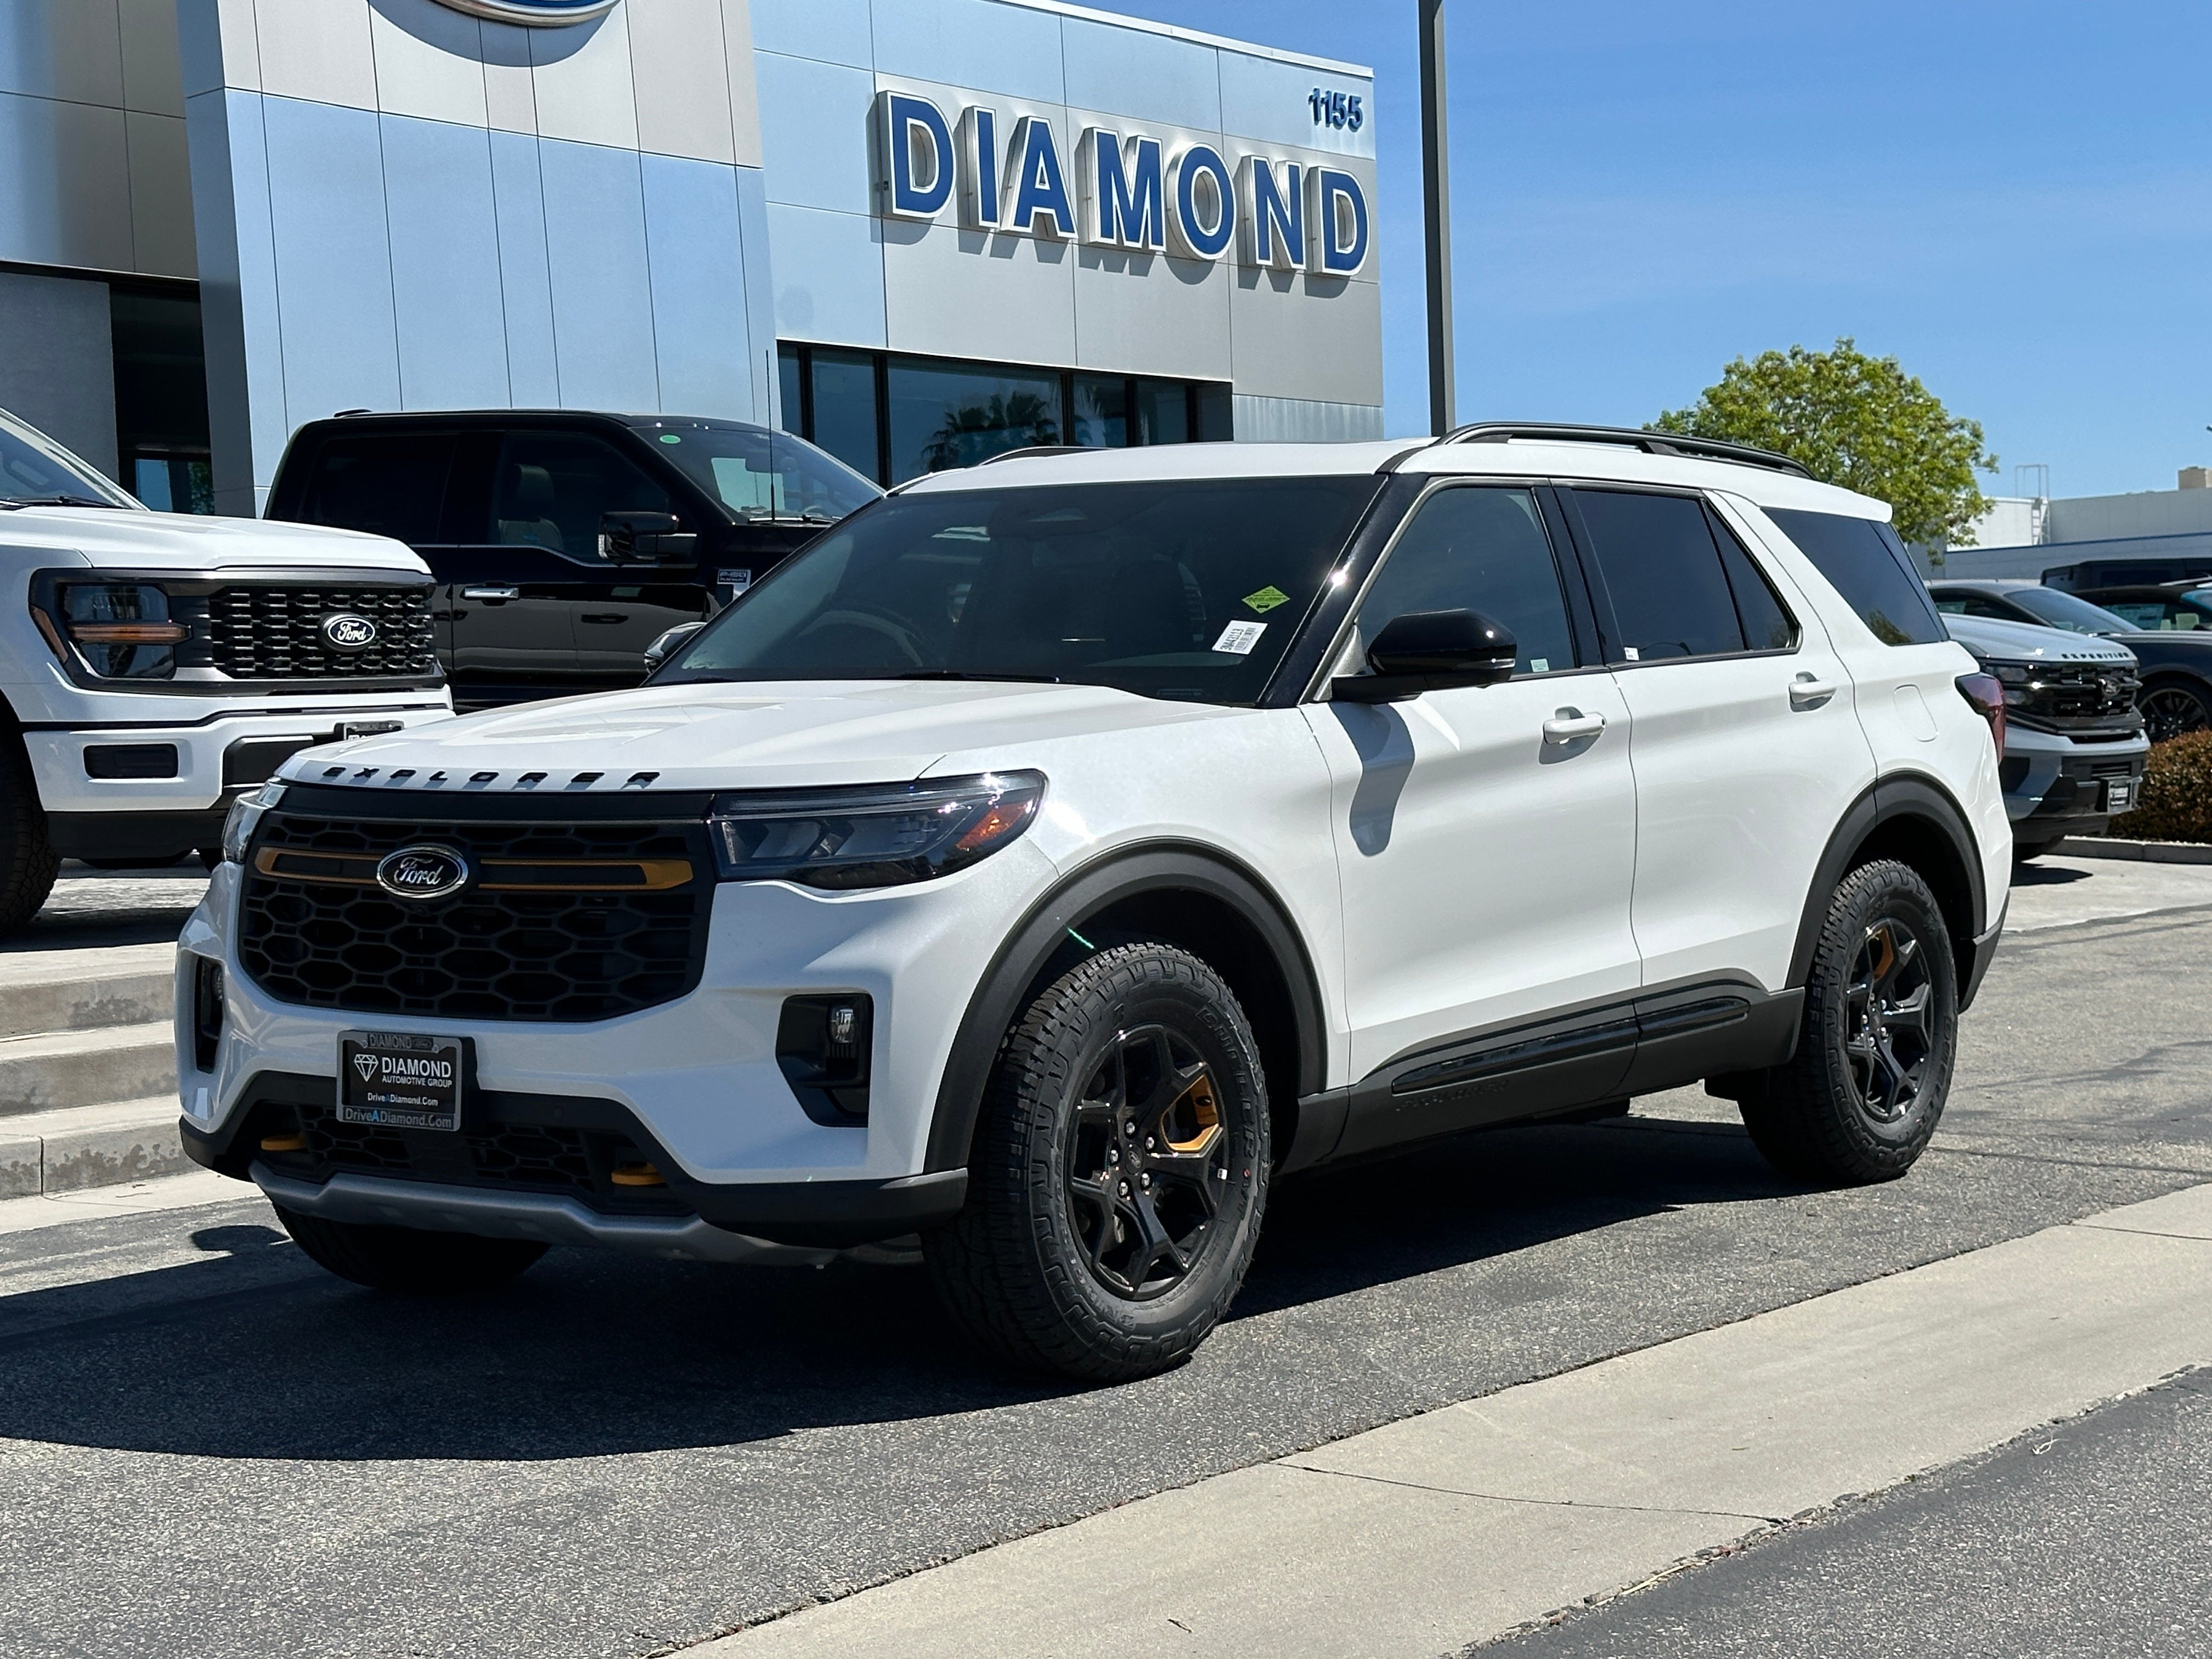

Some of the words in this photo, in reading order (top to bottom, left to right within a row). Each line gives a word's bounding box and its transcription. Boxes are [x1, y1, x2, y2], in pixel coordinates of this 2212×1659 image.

[1308, 88, 1363, 132] 1155
[885, 89, 1370, 276] DIAMOND
[337, 622, 366, 641] Ford
[322, 766, 661, 783] EXPLORER
[393, 856, 444, 885] Ford
[369, 1034, 412, 1048] DIAMOND
[382, 1057, 452, 1077] DIAMOND
[382, 1075, 426, 1086] AUTOMOTIVE
[427, 1078, 453, 1088] GROUP
[367, 1092, 438, 1106] DriveADiamond.Com
[345, 1108, 452, 1127] DriveADiamond.Com
